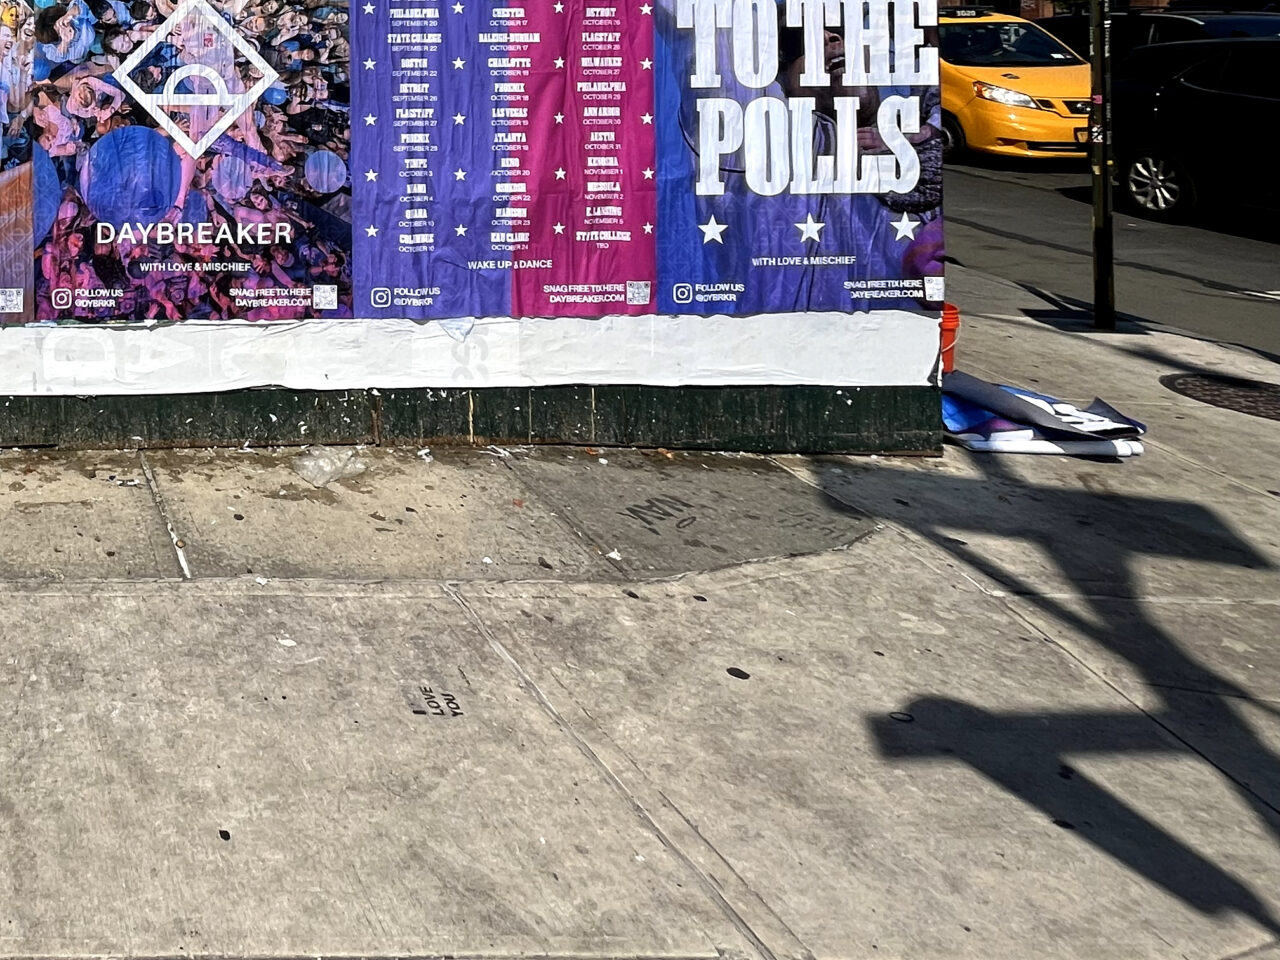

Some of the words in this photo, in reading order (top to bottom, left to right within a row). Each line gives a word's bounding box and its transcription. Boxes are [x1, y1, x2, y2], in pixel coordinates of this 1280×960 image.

[696, 95, 920, 196] POLLS
[96, 222, 292, 244] DAYBREAKER
[468, 260, 496, 269] WAKE
[497, 260, 512, 269] UP
[520, 260, 552, 269] DANCE
[752, 257, 776, 266] WITH
[777, 257, 801, 266] LOVE
[803, 257, 809, 265] &
[811, 256, 856, 265] MISCHIEF
[140, 263, 167, 272] WITH
[168, 263, 193, 272] LOVE
[194, 263, 201, 272] &
[202, 263, 251, 272] MISCHIEF
[75, 289, 109, 297] FOLLOW
[110, 289, 123, 297] US
[230, 288, 254, 297] SNAG
[255, 289, 275, 297] FREE
[235, 298, 311, 307] DAYBREAKER.COM
[549, 293, 625, 303] DAYBREAKER.COM
[75, 299, 116, 308] @DYBRKR
[419, 687, 445, 715] LOVE
[441, 693, 463, 716] YOU
